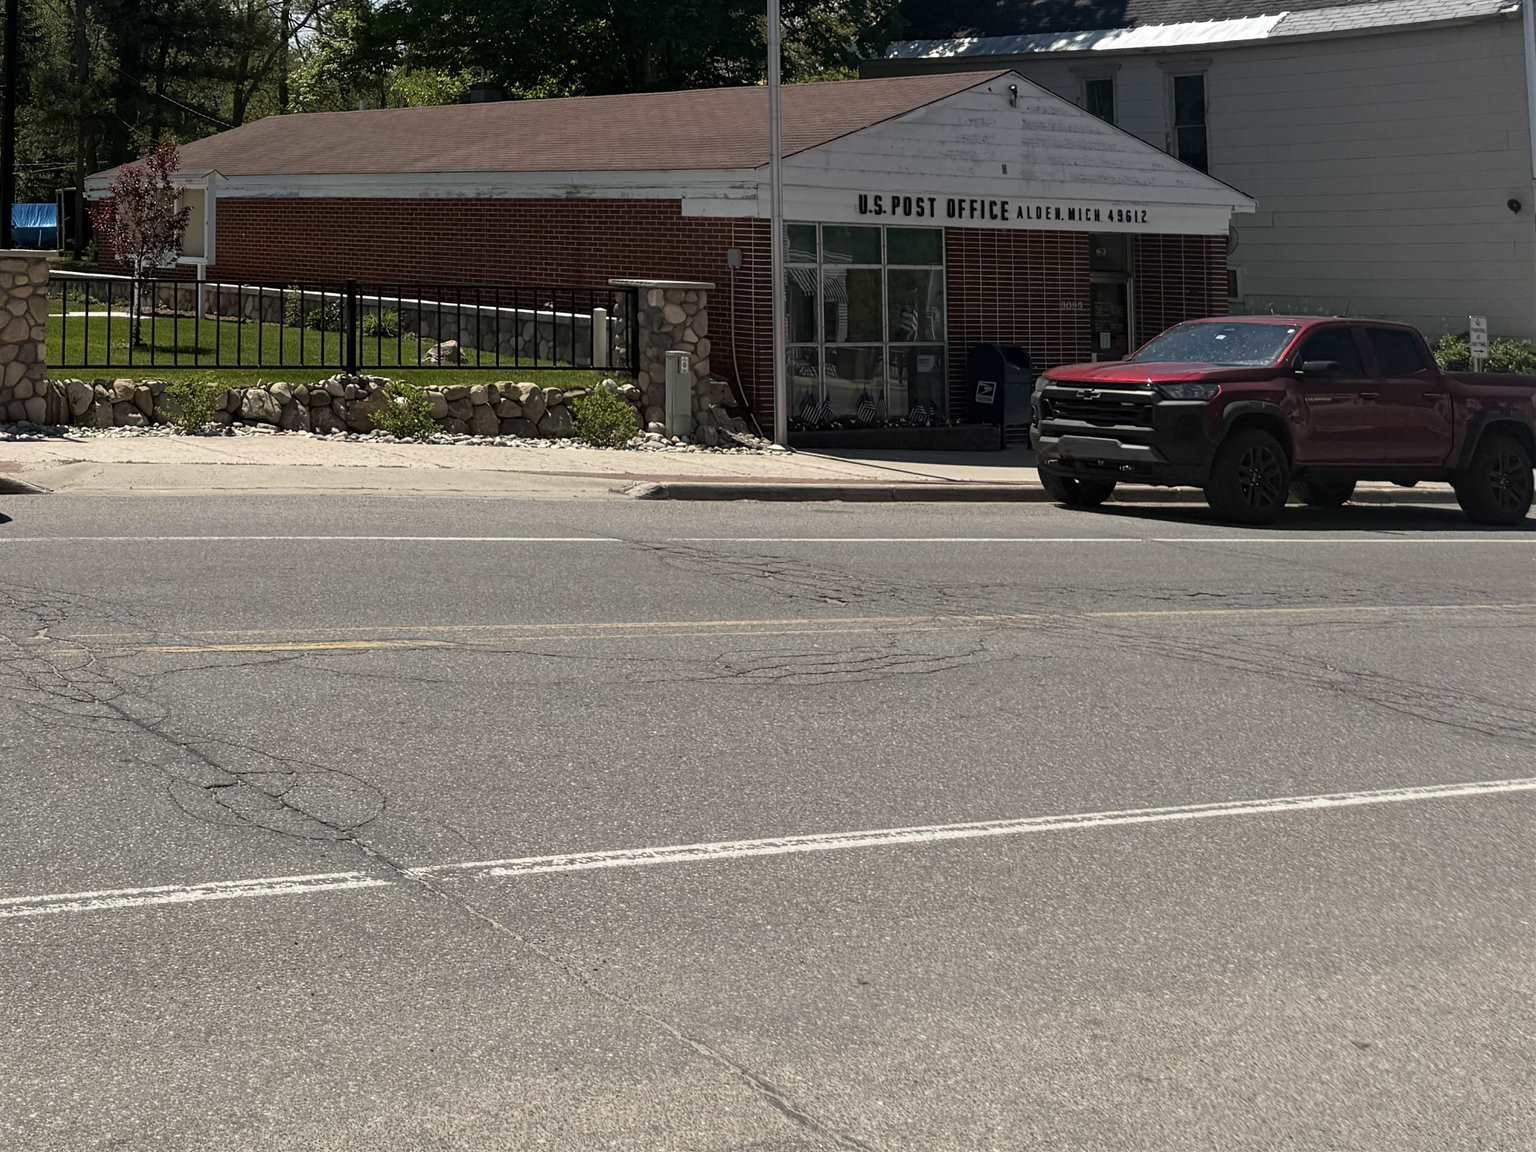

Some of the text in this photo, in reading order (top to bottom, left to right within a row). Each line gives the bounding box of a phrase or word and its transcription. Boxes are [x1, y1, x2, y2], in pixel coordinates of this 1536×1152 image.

[858, 194, 887, 215] U.S.
[891, 196, 937, 218] POST
[947, 198, 1009, 221] OFFICE
[1107, 208, 1148, 223] 49612
